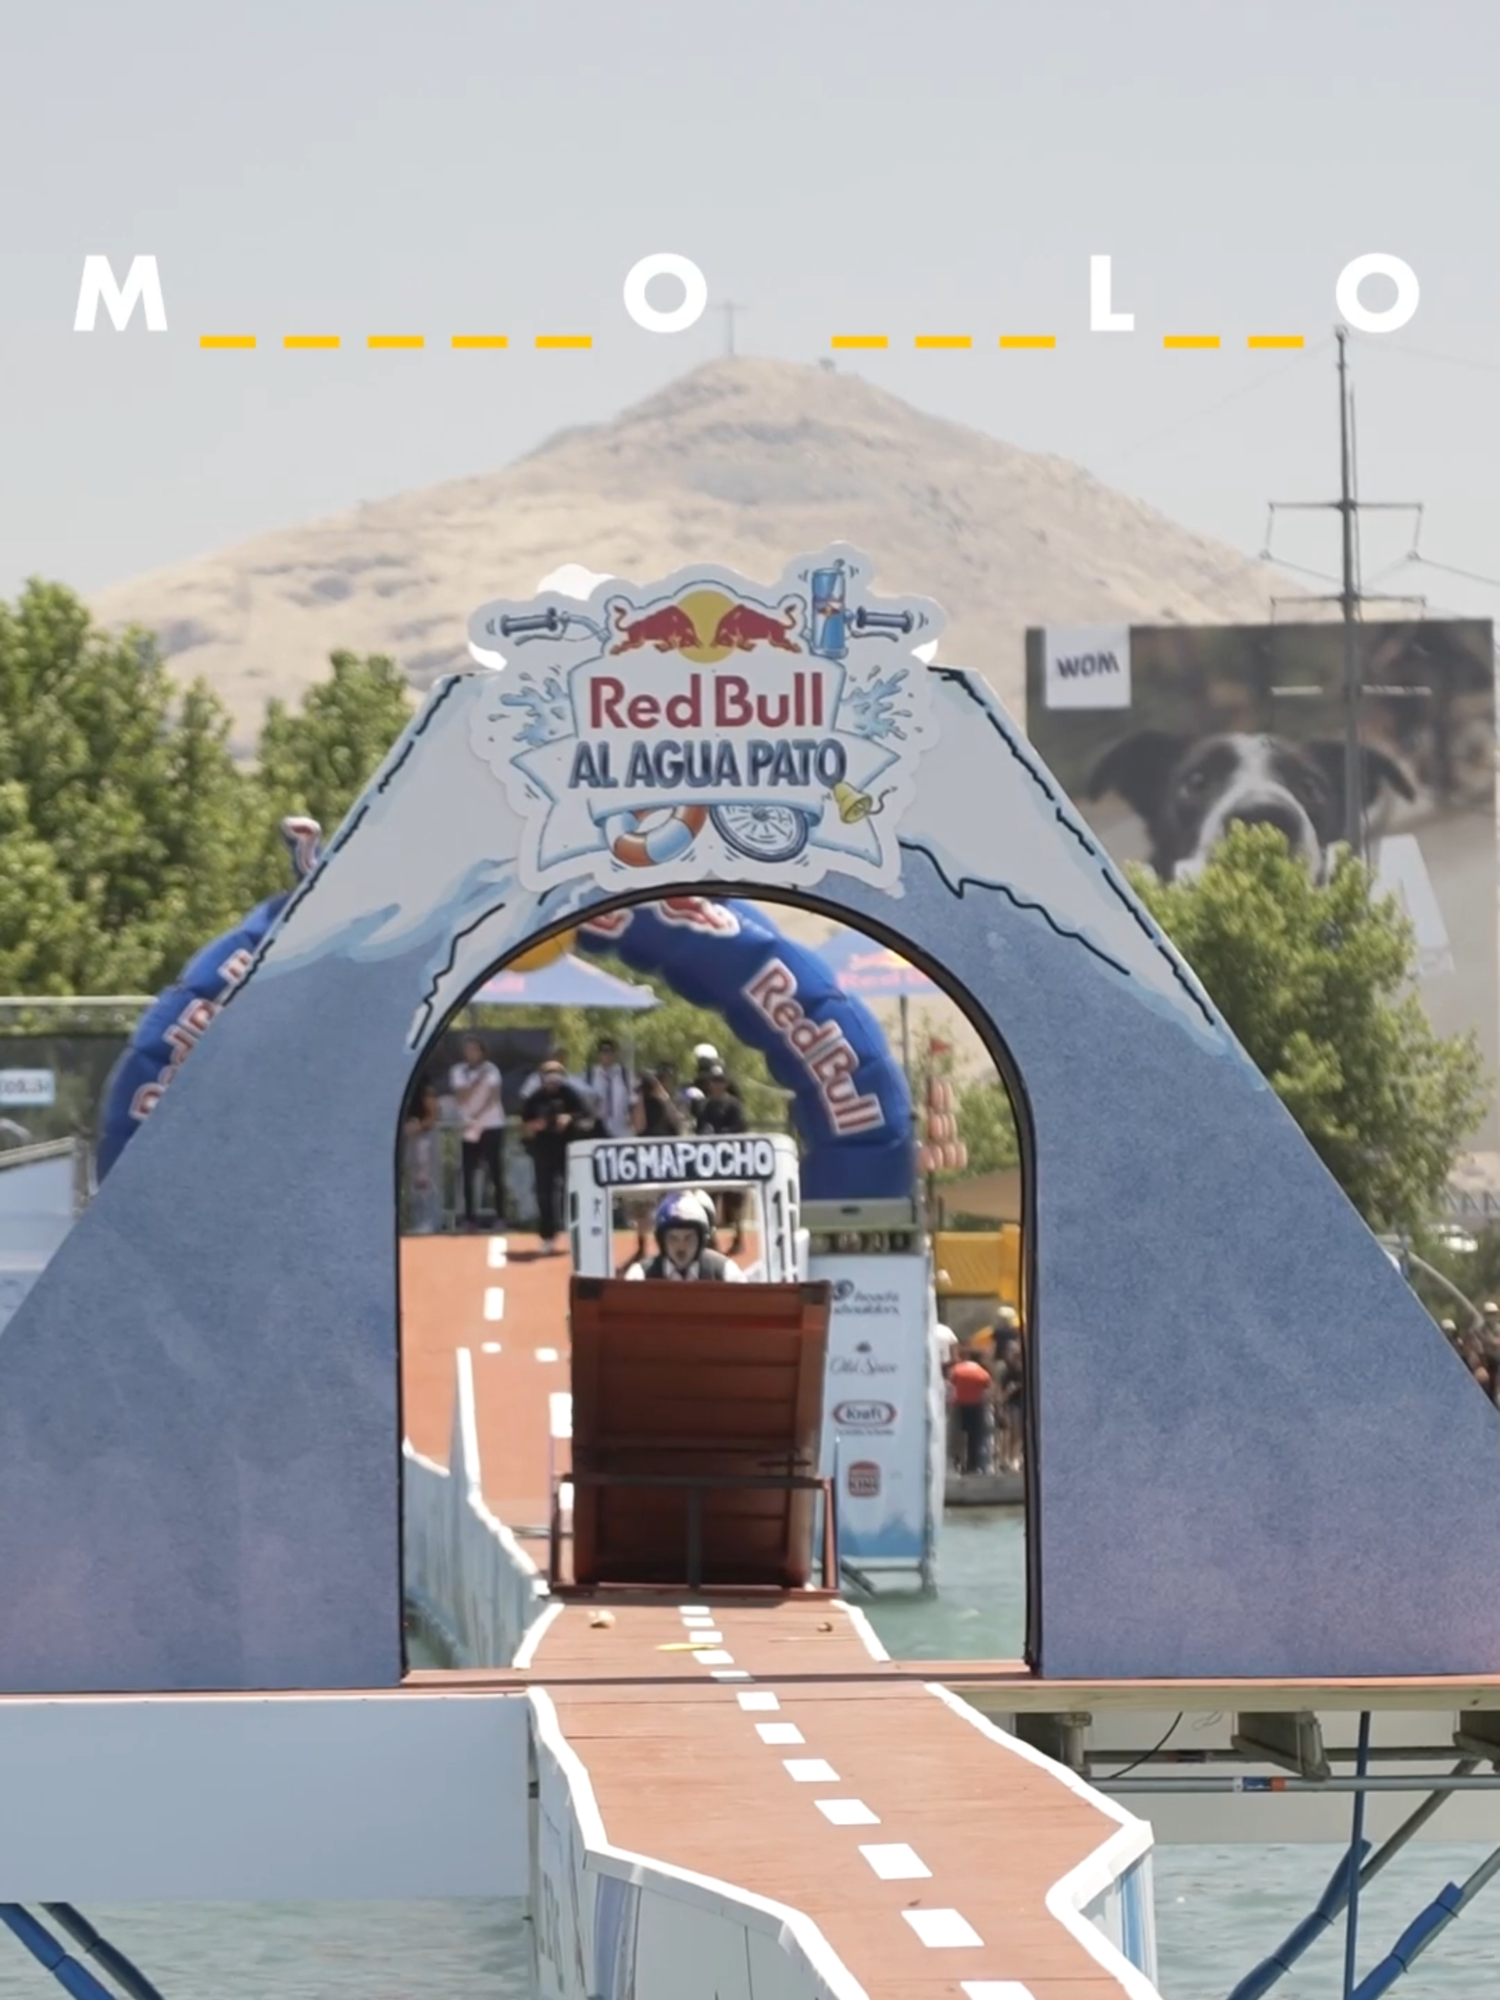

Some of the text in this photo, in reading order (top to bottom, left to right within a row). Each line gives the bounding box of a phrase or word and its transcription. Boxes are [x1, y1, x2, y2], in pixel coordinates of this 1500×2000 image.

[1057, 650, 1120, 678] WOM
[590, 672, 823, 729] Red Bull
[568, 738, 847, 789] AL AGUA PATO
[742, 958, 885, 1136] Red Bull
